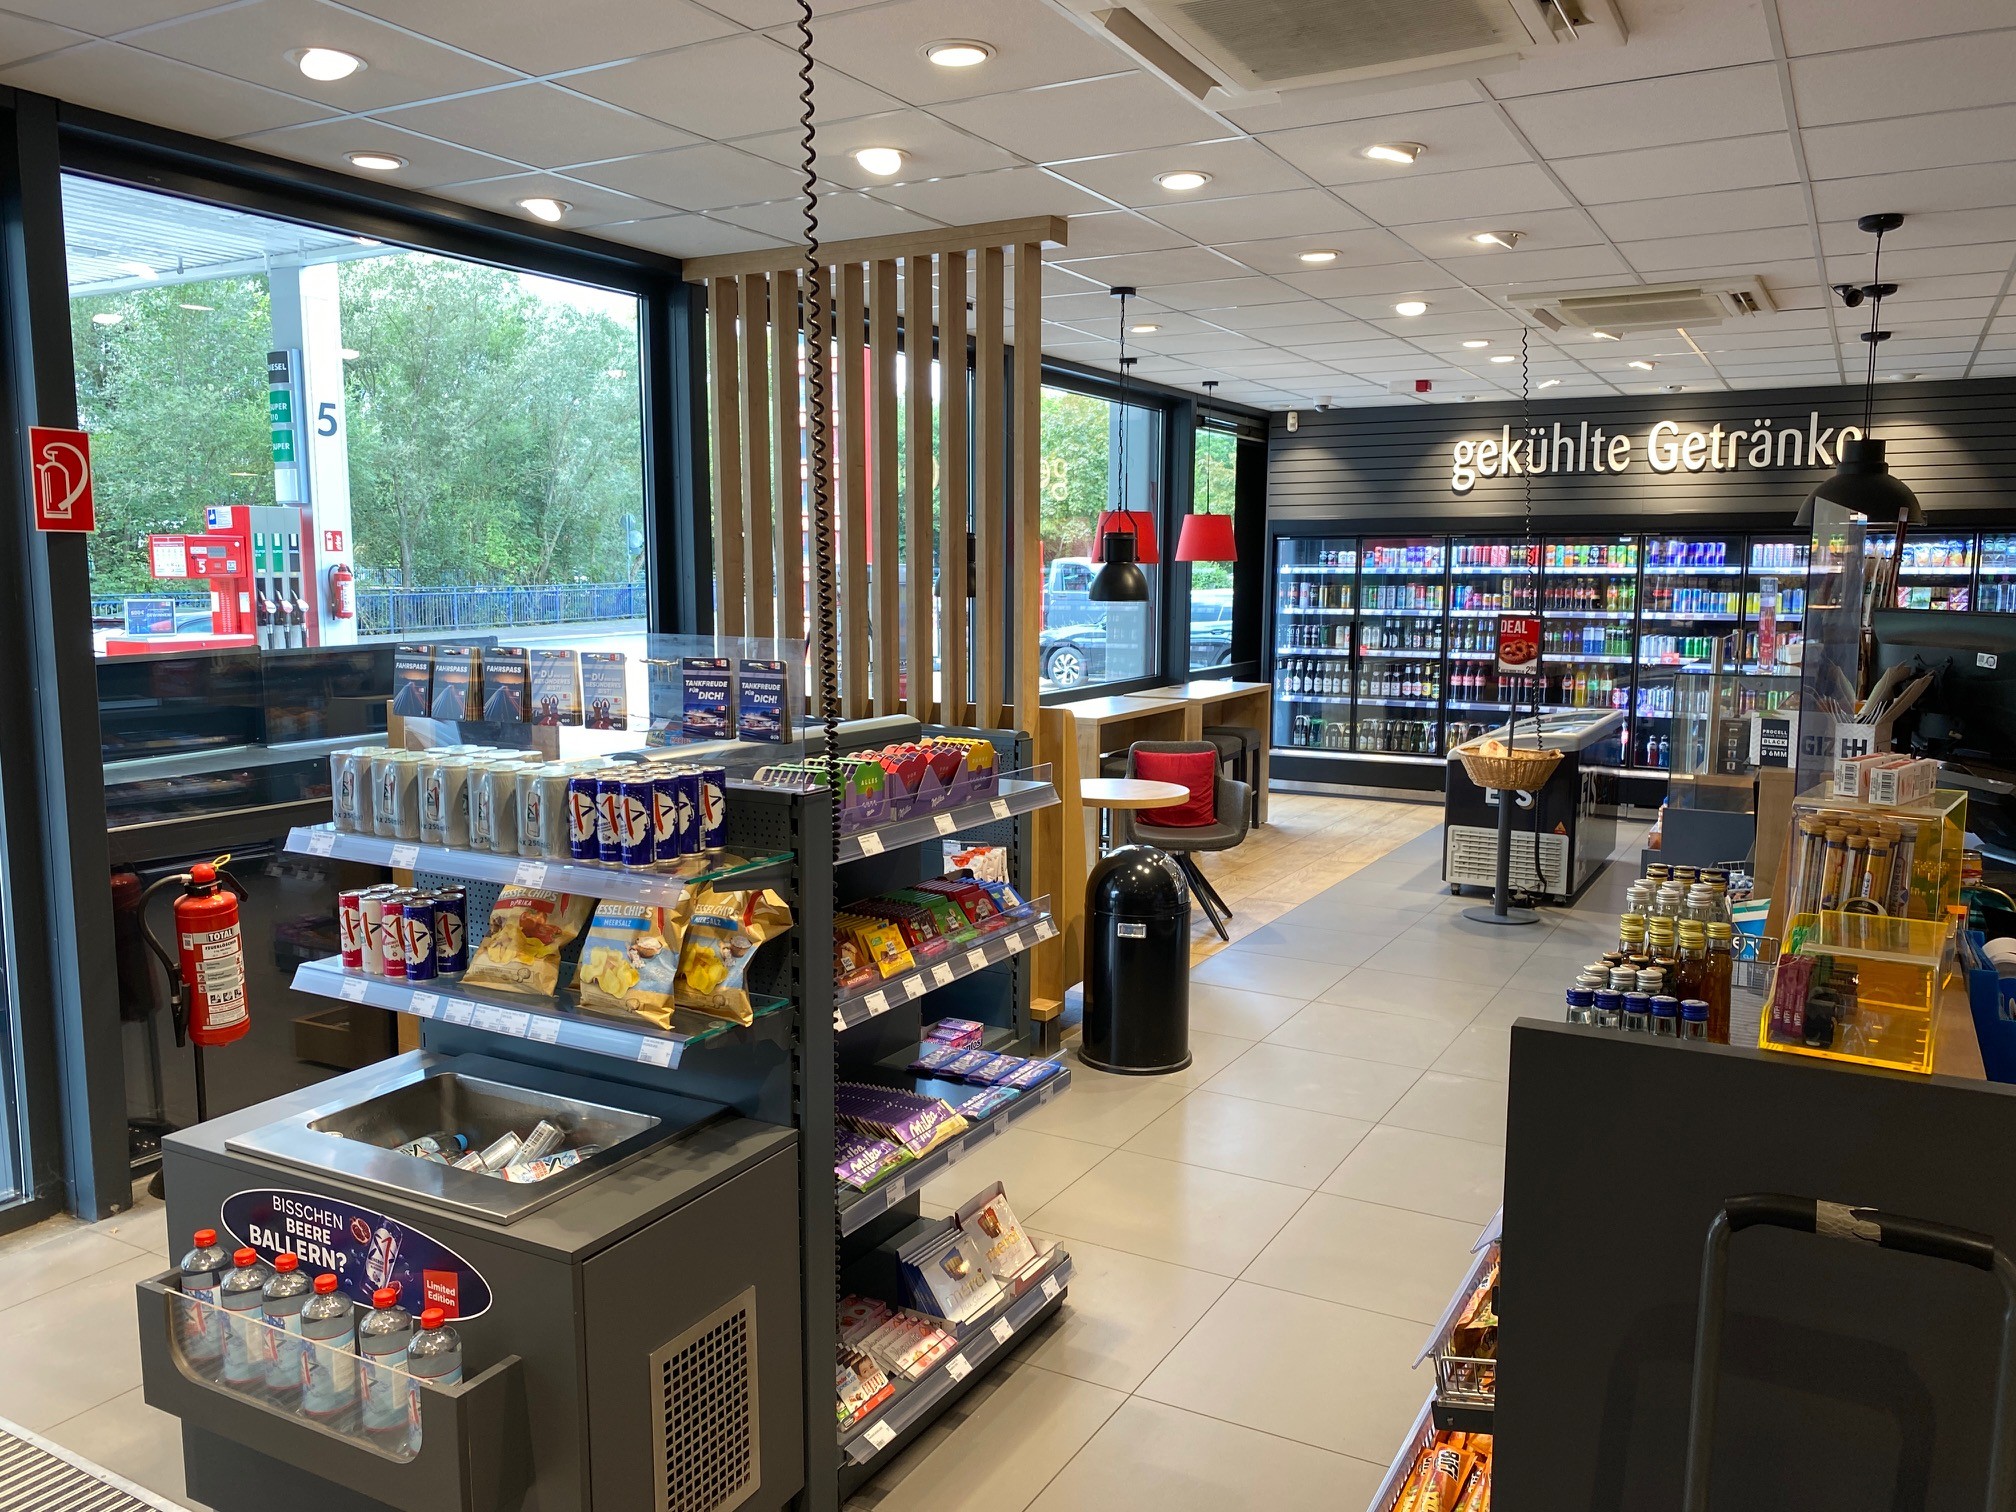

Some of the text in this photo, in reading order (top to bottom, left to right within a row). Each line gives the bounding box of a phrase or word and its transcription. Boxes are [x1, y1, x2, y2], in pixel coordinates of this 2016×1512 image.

[318, 402, 338, 437] 5
[1451, 420, 1631, 492] gekühlte
[198, 561, 206, 573] 5
[1501, 619, 1528, 634] DEAL
[395, 662, 428, 671] FAHRSPASS
[435, 665, 468, 673] FAHRSPASS
[486, 665, 522, 674] FAHRSPASS
[685, 679, 728, 688] TANKFREUDE
[742, 682, 781, 691] TANKFREUDE
[698, 691, 725, 701] DICH!
[753, 695, 778, 704] DICH!
[1762, 728, 1788, 736] PROCELL
[861, 777, 878, 786] ALLES
[1485, 787, 1533, 807] ES
[527, 888, 559, 901] CHIPS
[622, 905, 654, 918] CHIPS
[693, 903, 712, 915] ESSEL
[603, 919, 632, 928] MEERSALZ
[208, 928, 233, 942] TOTAL
[909, 1110, 939, 1143] Milka
[850, 1147, 882, 1177] Milka
[272, 1195, 343, 1230] BISSCHEN
[286, 1217, 331, 1245] BEERE
[249, 1223, 348, 1274] BALLERN?
[985, 1225, 1021, 1263] merci
[425, 1280, 456, 1297] Limited
[946, 1267, 987, 1308] merci
[427, 1291, 456, 1307] Edition
